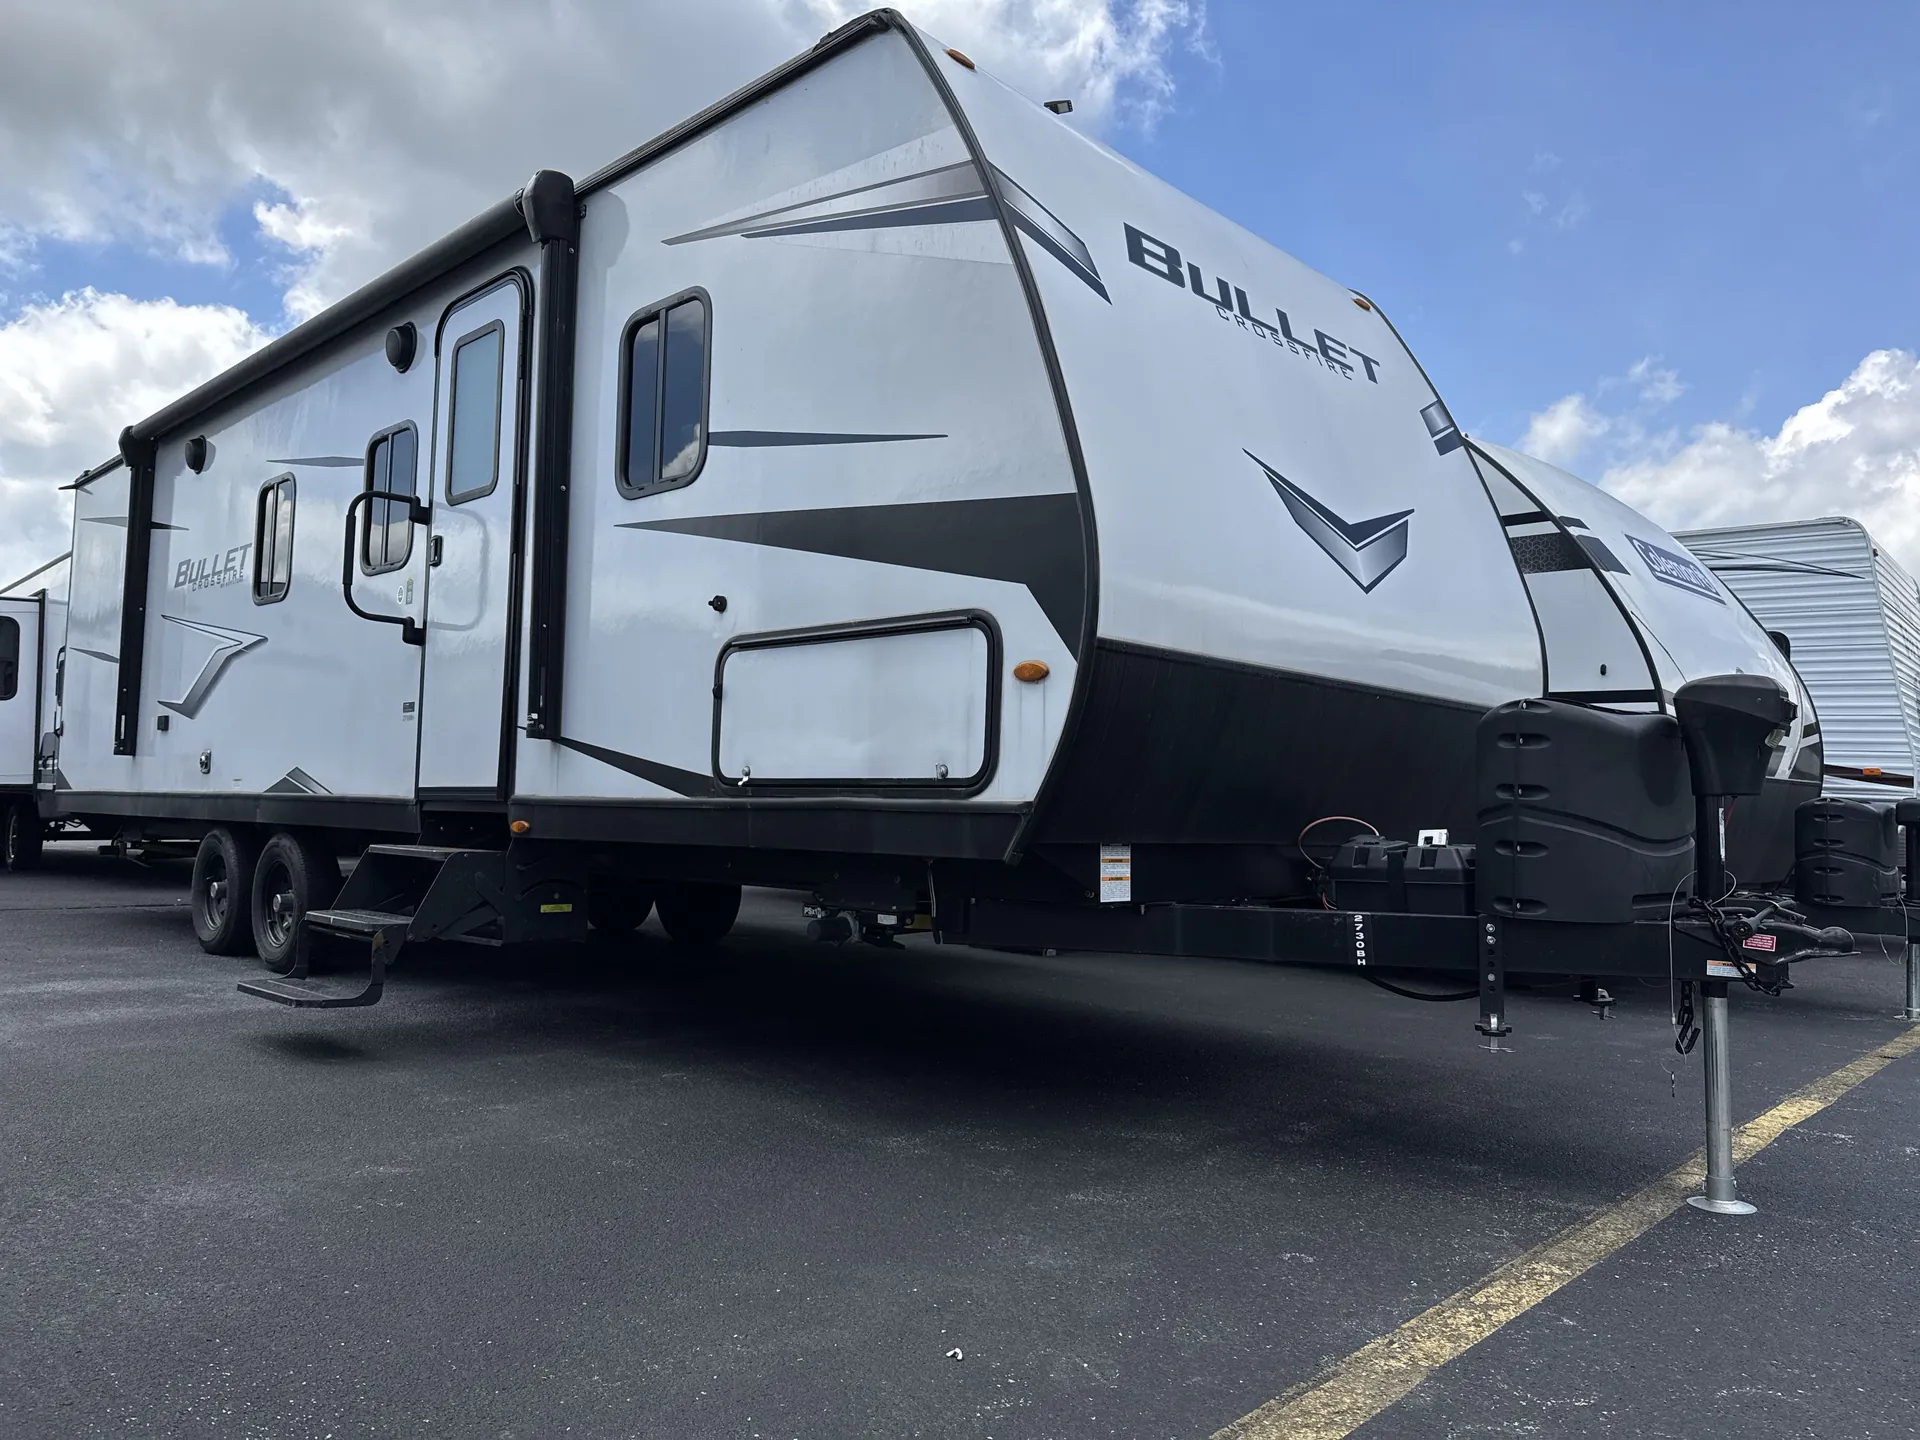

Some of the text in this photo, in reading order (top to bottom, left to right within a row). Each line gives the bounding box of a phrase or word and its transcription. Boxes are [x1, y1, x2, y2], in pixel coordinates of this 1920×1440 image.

[1123, 221, 1380, 384] BULLET
[1215, 304, 1353, 381] CROSSFIRE
[174, 542, 253, 588] BULLET
[191, 567, 244, 592] CROSSFIRE
[1632, 539, 1706, 588] Coleman
[1353, 914, 1367, 966] 2730BH
